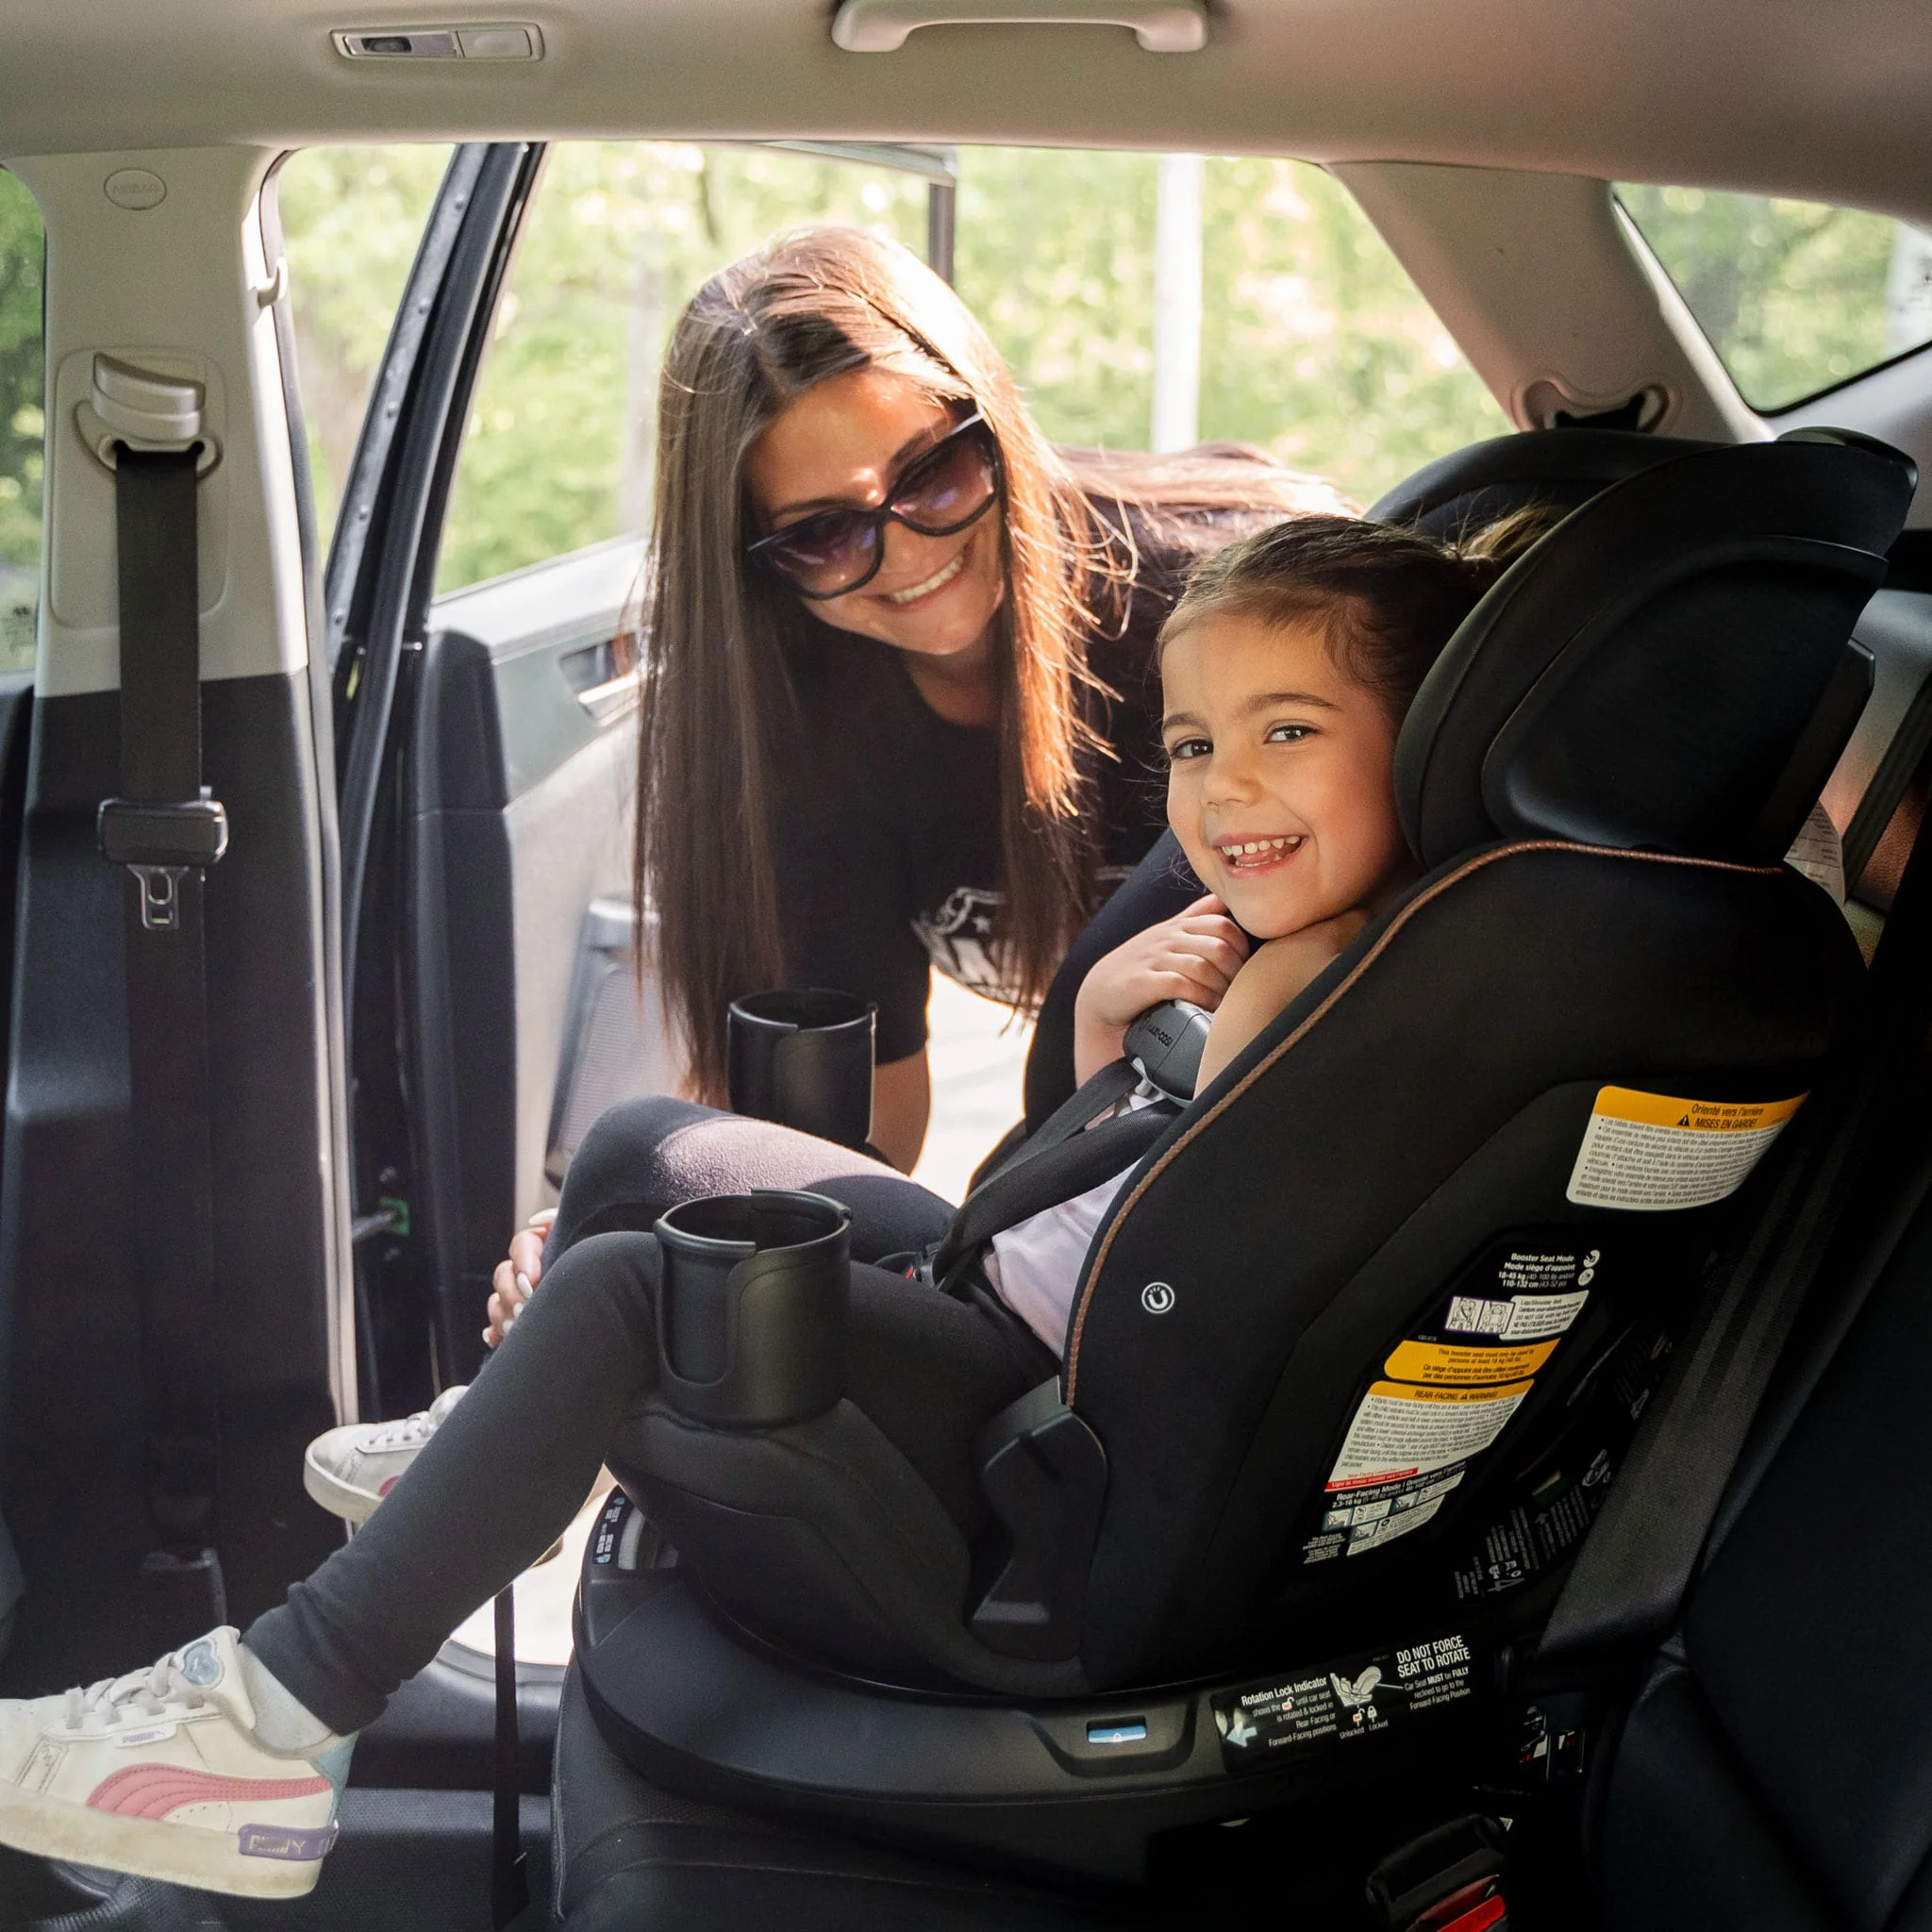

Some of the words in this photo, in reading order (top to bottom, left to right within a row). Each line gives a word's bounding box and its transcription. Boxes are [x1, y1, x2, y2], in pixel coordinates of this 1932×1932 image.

[1695, 1118, 1720, 1128] MISES
[1721, 1119, 1732, 1128] EN
[1511, 1253, 1539, 1261] Booster
[1504, 1261, 1524, 1270] Mode
[1517, 1272, 1525, 1280] kg
[1396, 1649, 1411, 1664] DO
[1412, 1643, 1431, 1659] NOT
[1432, 1635, 1464, 1654] FORCE
[1397, 1659, 1421, 1678] SEAT
[1422, 1657, 1435, 1671] TO
[1436, 1647, 1471, 1667] ROTATE
[1405, 1682, 1415, 1691] Car
[1427, 1674, 1444, 1685] MUST
[1452, 1666, 1470, 1677] FULLY
[1241, 1690, 1274, 1706] Rotation
[1274, 1685, 1293, 1698] Lock
[1294, 1677, 1326, 1692] Indicator
[1414, 1686, 1435, 1699] reclined
[1436, 1685, 1441, 1693] to
[1441, 1683, 1449, 1693] go
[1455, 1679, 1464, 1688] the
[1252, 1707, 1271, 1717] shows
[1271, 1704, 1281, 1712] the
[1283, 1709, 1303, 1721] rotated
